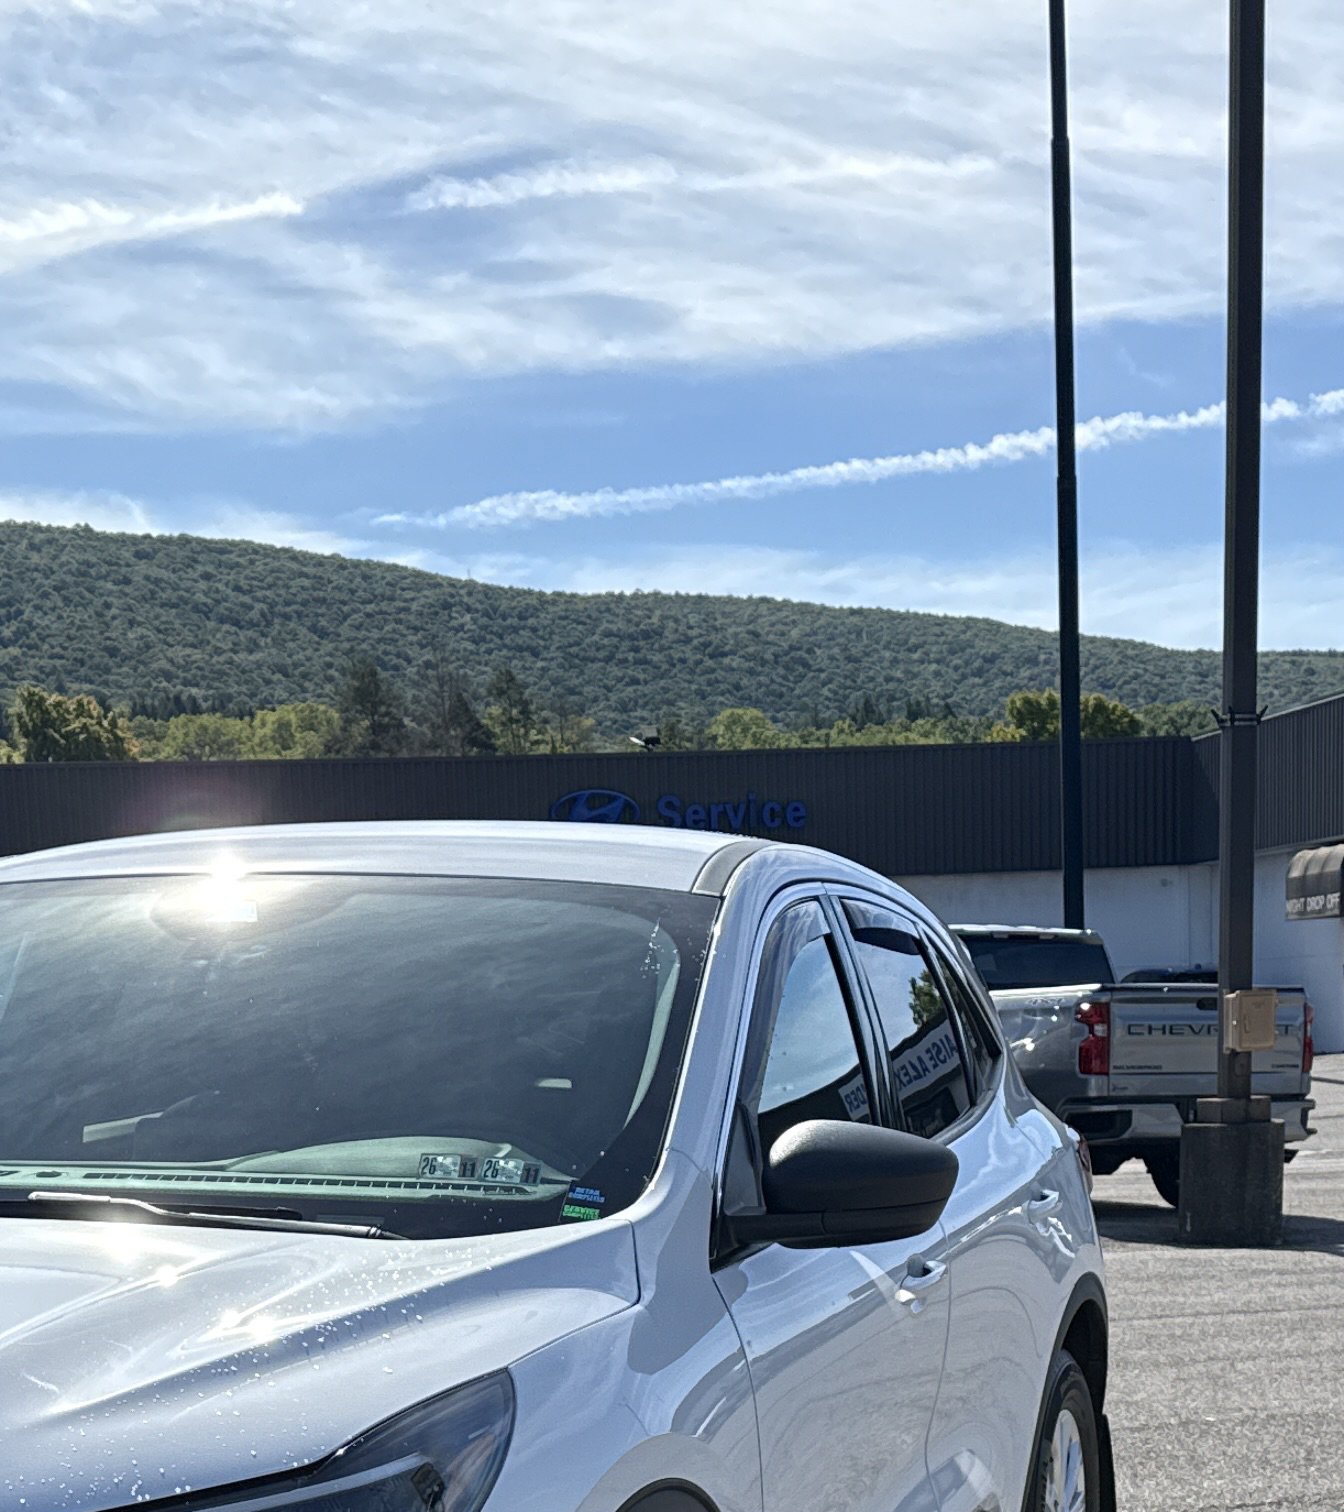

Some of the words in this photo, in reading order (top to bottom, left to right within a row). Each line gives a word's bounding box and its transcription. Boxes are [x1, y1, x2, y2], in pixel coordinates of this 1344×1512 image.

[657, 792, 806, 829] Service
[1127, 1023, 1294, 1036] CHEVRT
[421, 1154, 437, 1176] 26
